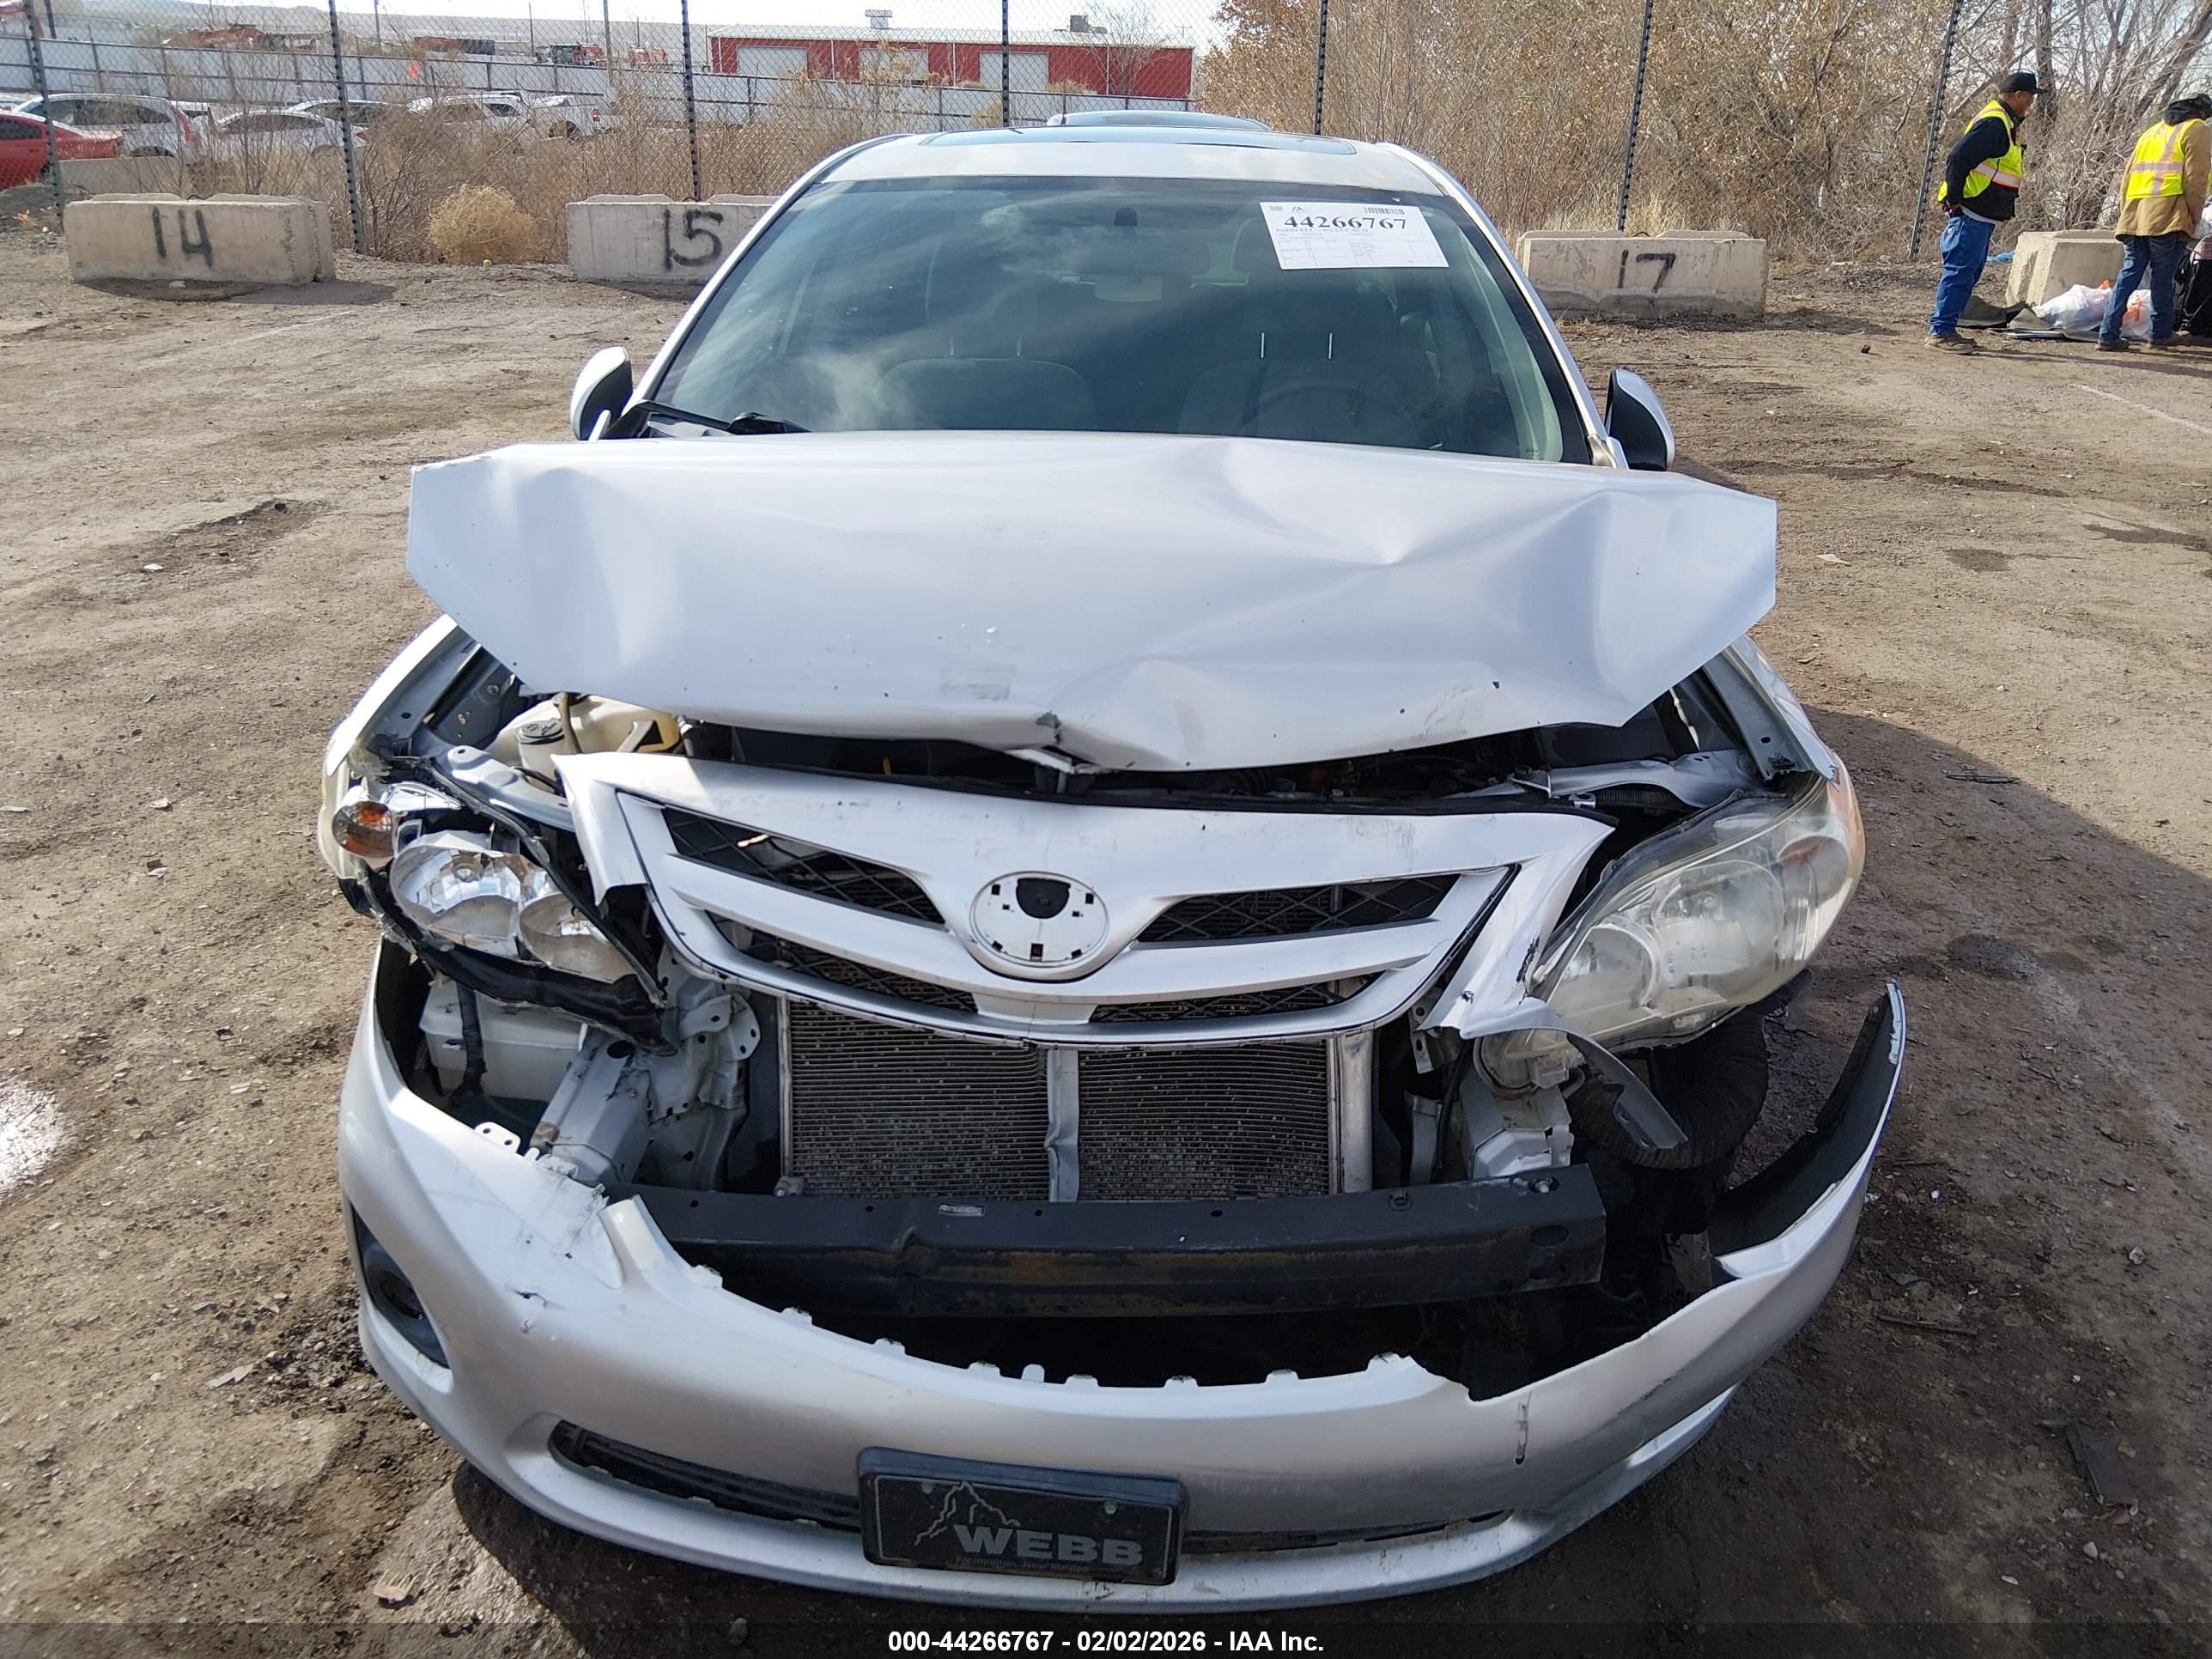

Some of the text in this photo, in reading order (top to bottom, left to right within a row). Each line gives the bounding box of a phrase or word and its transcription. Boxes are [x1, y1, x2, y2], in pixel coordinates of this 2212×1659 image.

[152, 205, 214, 268] 14
[663, 208, 724, 270] 15
[1284, 216, 1407, 231] 44266767
[1618, 249, 1677, 293] 17
[953, 1523, 1144, 1566] WEBB
